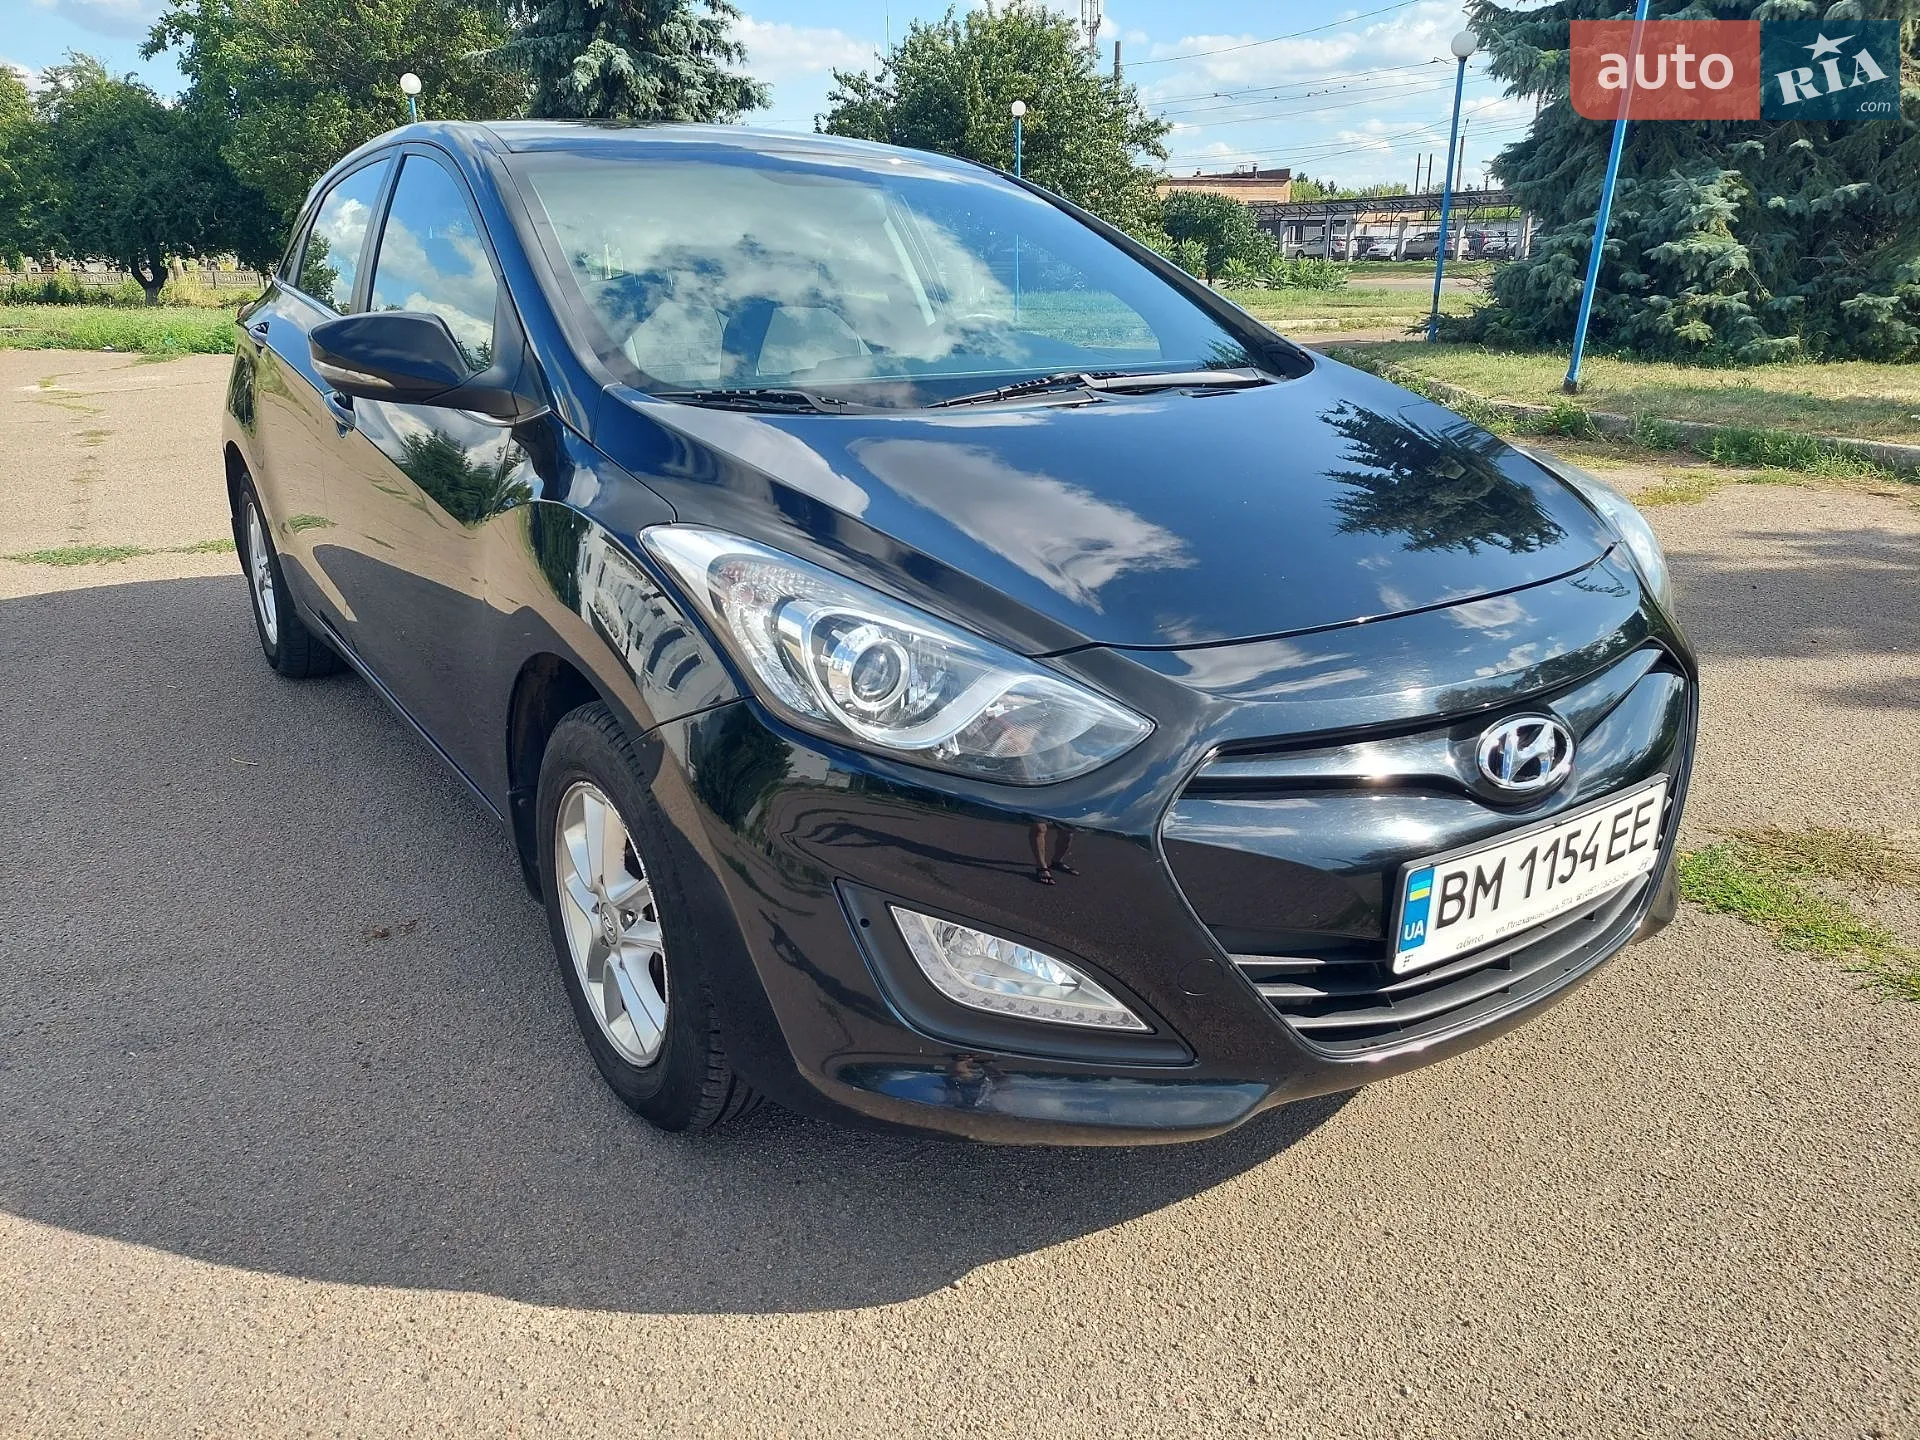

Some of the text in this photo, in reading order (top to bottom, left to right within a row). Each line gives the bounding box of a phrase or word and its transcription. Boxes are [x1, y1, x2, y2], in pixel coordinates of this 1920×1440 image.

[1435, 797, 1655, 930] BM 1154 EE
[1404, 919, 1424, 941] UA
